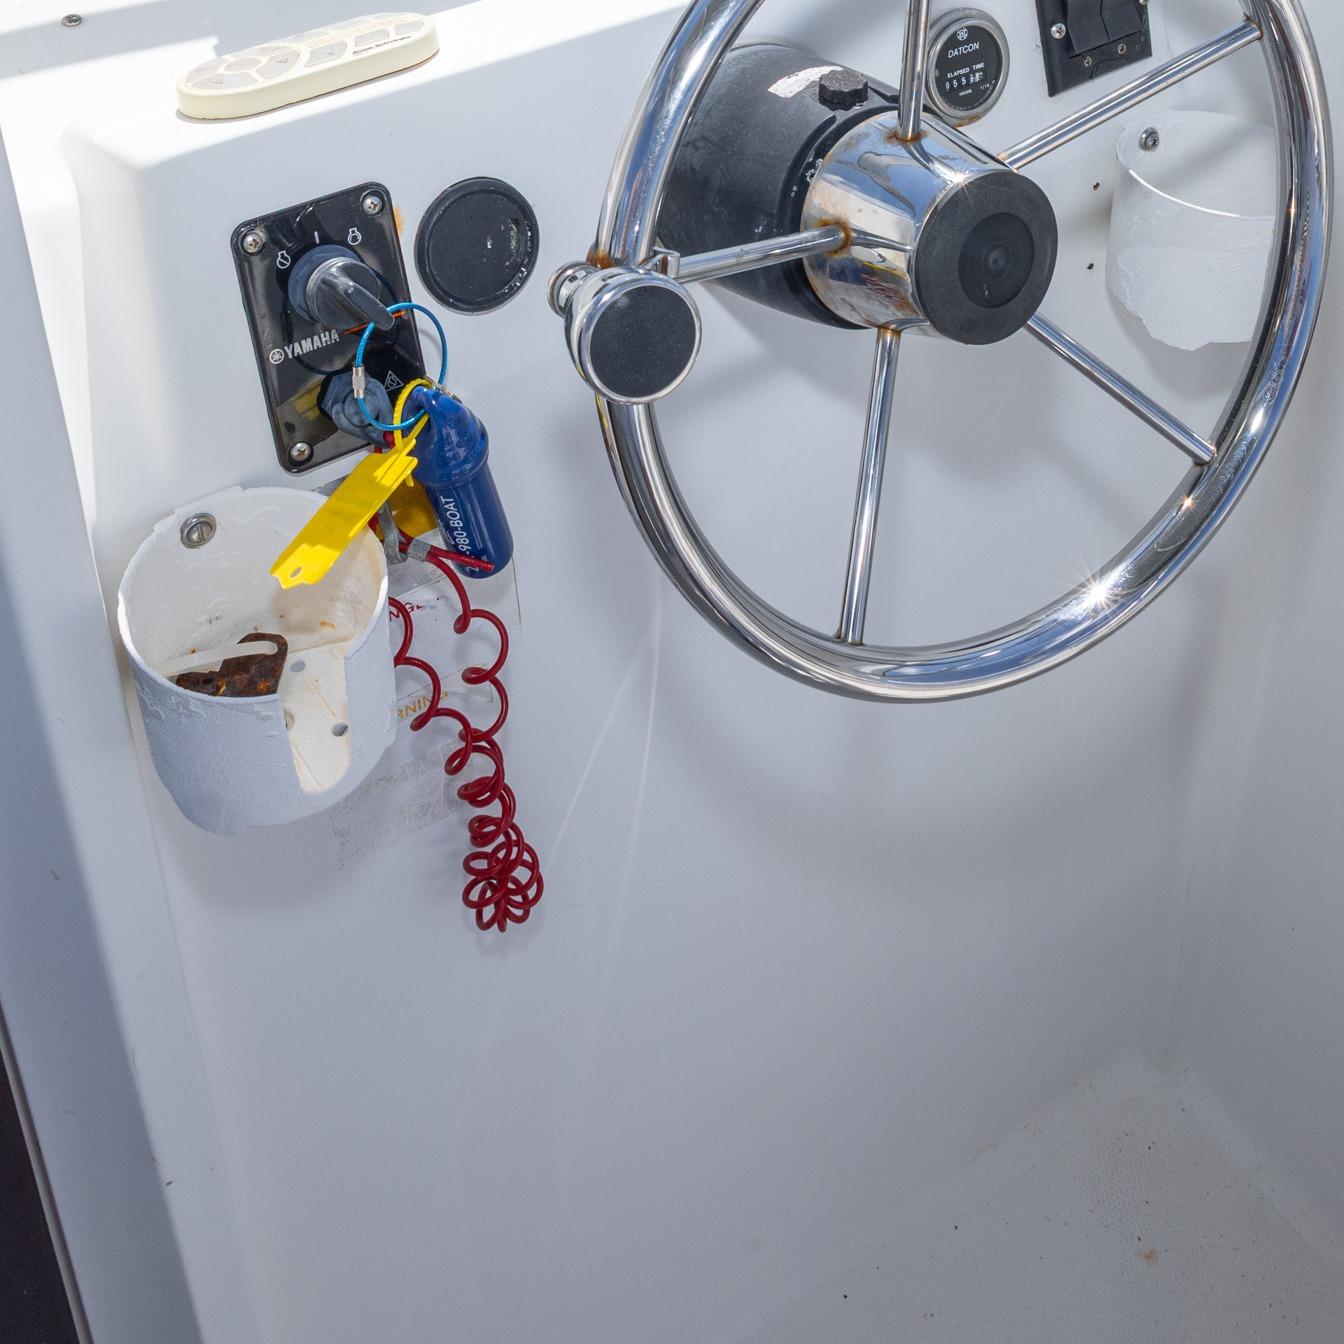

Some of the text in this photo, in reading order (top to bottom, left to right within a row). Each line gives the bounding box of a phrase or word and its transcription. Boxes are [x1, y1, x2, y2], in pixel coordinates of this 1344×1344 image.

[948, 41, 980, 58] DATCON
[947, 61, 986, 80] ELAPSED TIME
[284, 328, 341, 360] YAMAHA
